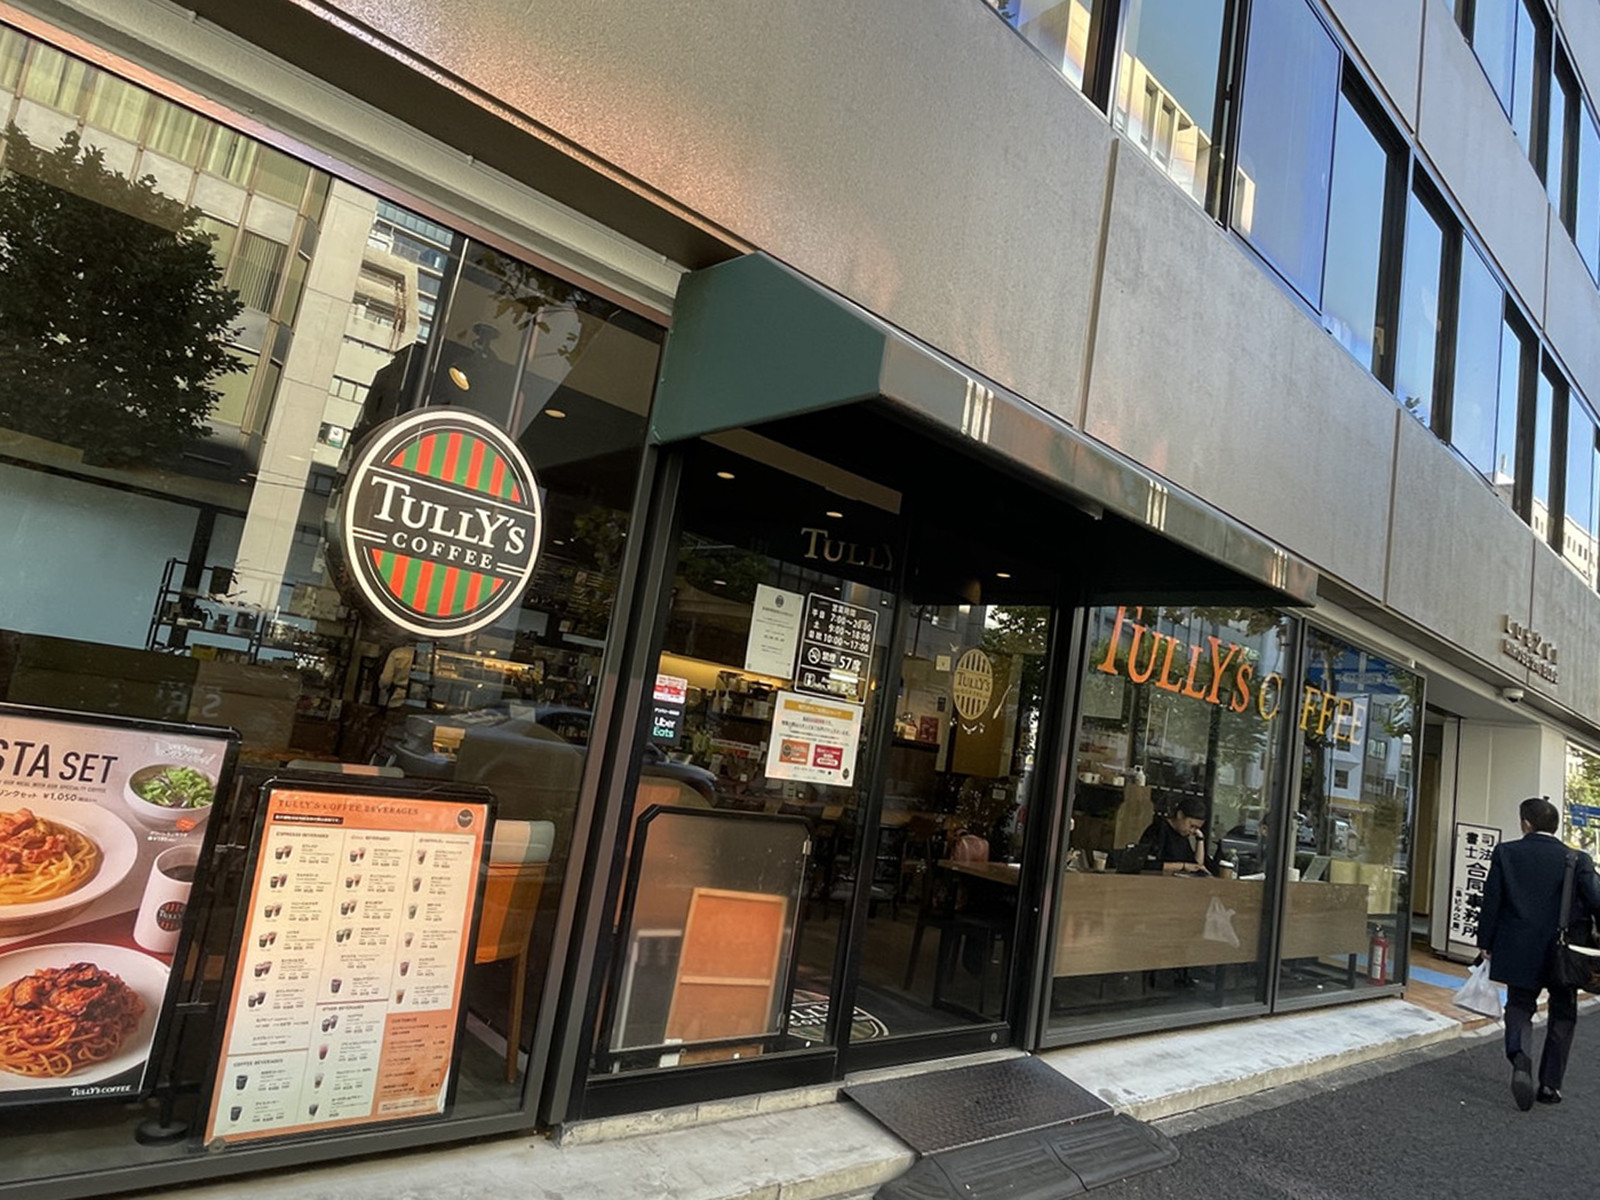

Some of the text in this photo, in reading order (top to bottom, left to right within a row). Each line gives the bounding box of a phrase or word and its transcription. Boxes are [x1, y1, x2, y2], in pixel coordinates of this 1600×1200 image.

[371, 475, 526, 555] TULLY'S
[392, 532, 493, 569] COFFEE
[653, 726, 675, 738] Eats
[654, 716, 676, 728] Uber
[59, 751, 118, 784] SET
